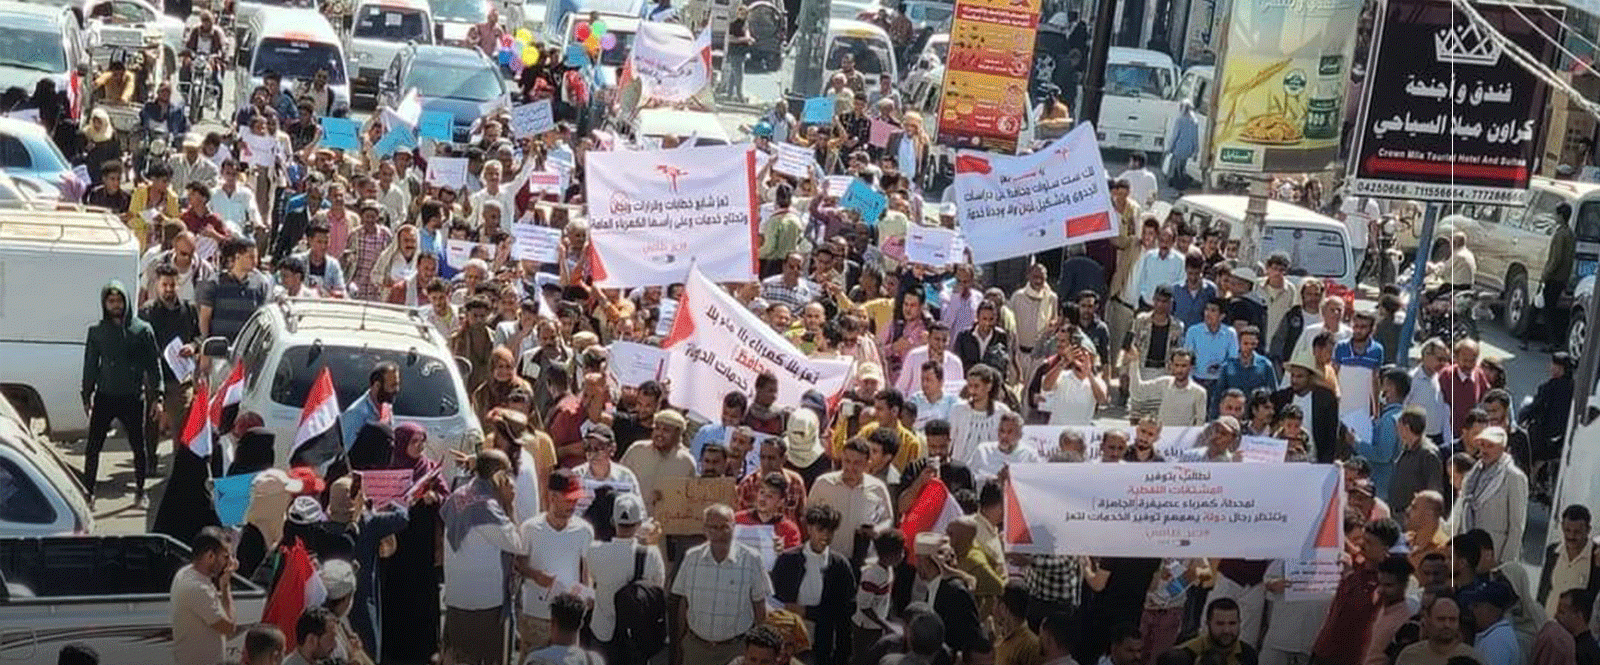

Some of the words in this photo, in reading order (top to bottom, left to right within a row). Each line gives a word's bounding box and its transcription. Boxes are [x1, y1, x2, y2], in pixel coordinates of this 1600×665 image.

[1470, 80, 1512, 106] فندق
[1373, 110, 1447, 139] السياحي
[1452, 115, 1483, 141] ميلا
[1487, 118, 1536, 144] كراون
[1378, 147, 1405, 159] Crown
[1458, 153, 1481, 164] Hotel
[1482, 154, 1499, 165] And
[665, 198, 694, 210] خطابات
[717, 196, 729, 208] تعز
[615, 217, 647, 231] الكهرباء
[675, 217, 693, 230] وعلى
[695, 213, 721, 226] خدمات
[723, 212, 748, 226] وتحتاج
[748, 337, 786, 367] كهرباء
[715, 360, 748, 392] خدمات
[783, 357, 799, 378] بلا
[799, 367, 820, 385] تعز
[1182, 498, 1219, 509] كهرباء
[1087, 512, 1131, 522] الخدمات
